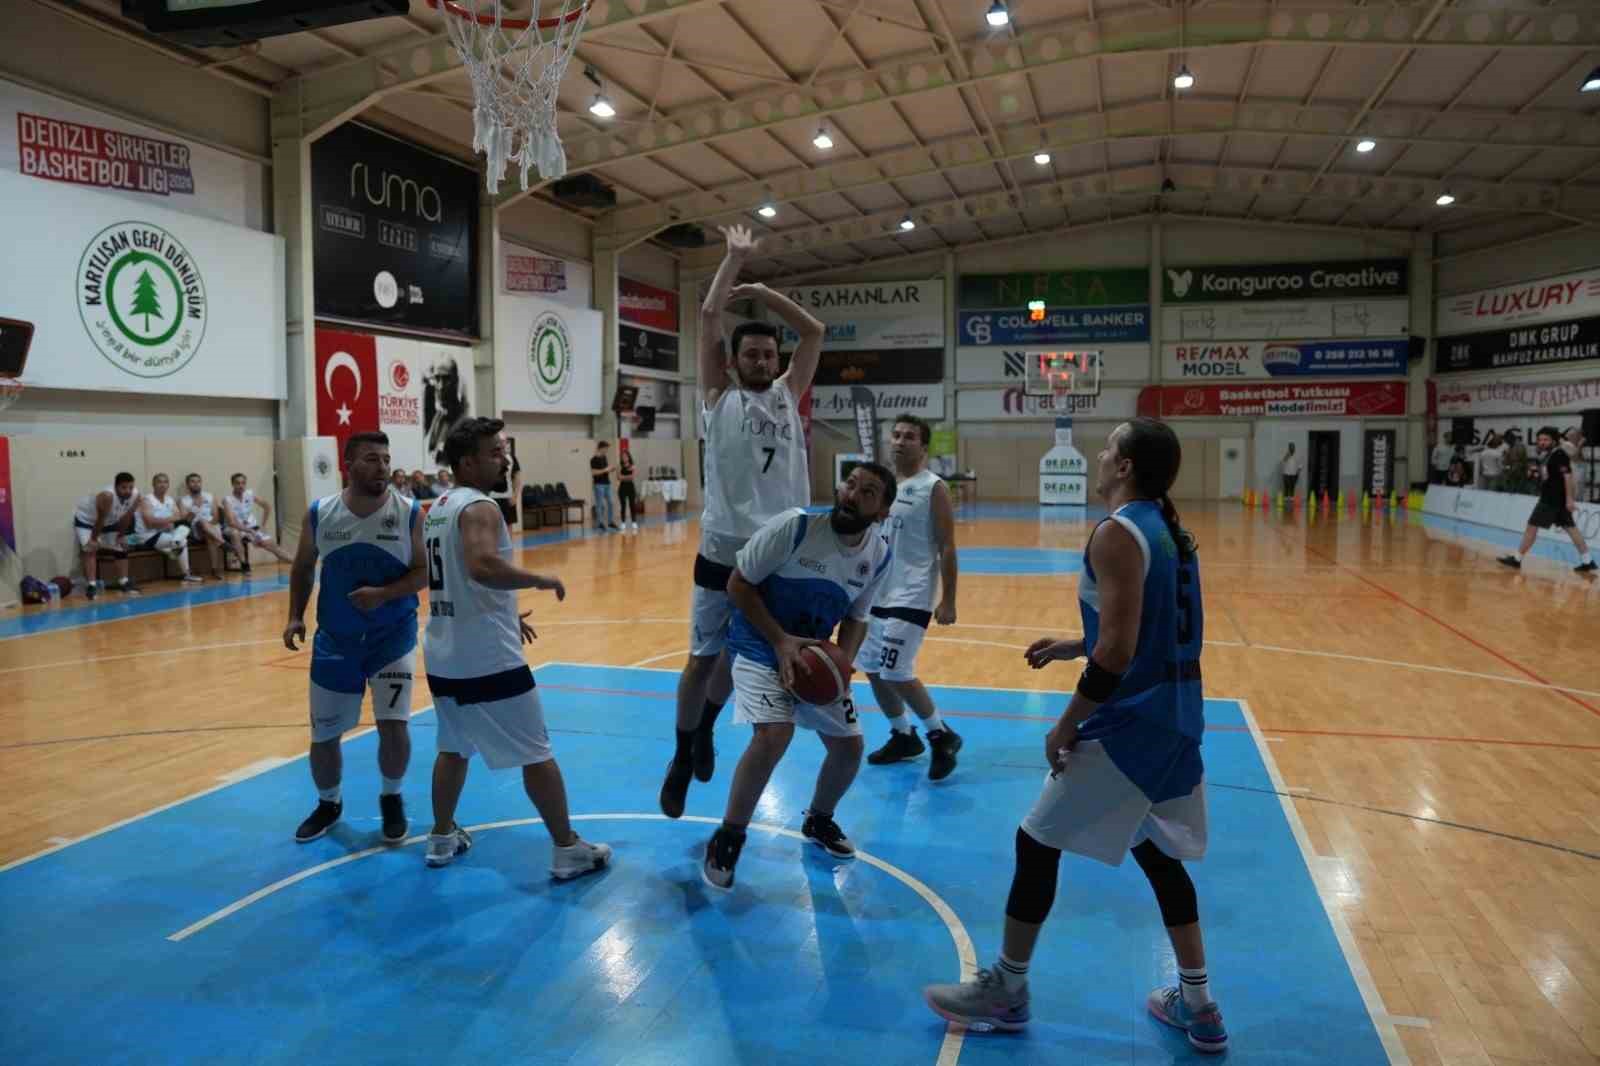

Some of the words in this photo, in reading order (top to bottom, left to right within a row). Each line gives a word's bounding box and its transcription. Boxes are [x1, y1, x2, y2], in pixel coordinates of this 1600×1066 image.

[351, 162, 441, 223] ruma
[84, 230, 131, 306] KARTLISAN
[1202, 271, 1303, 297] Kanguroo
[1310, 266, 1400, 288] Creative
[1475, 279, 1584, 317] LUXURY
[1083, 312, 1145, 327] BANKER
[1509, 328, 1538, 348] DMK
[1540, 323, 1580, 345] GRUP
[1175, 346, 1250, 361] RE/MAX
[1182, 361, 1247, 376] MODEL
[1219, 388, 1289, 400] Basketbol
[1292, 386, 1350, 398] Tutkusu
[762, 446, 776, 474] 7
[388, 683, 403, 709] 7
